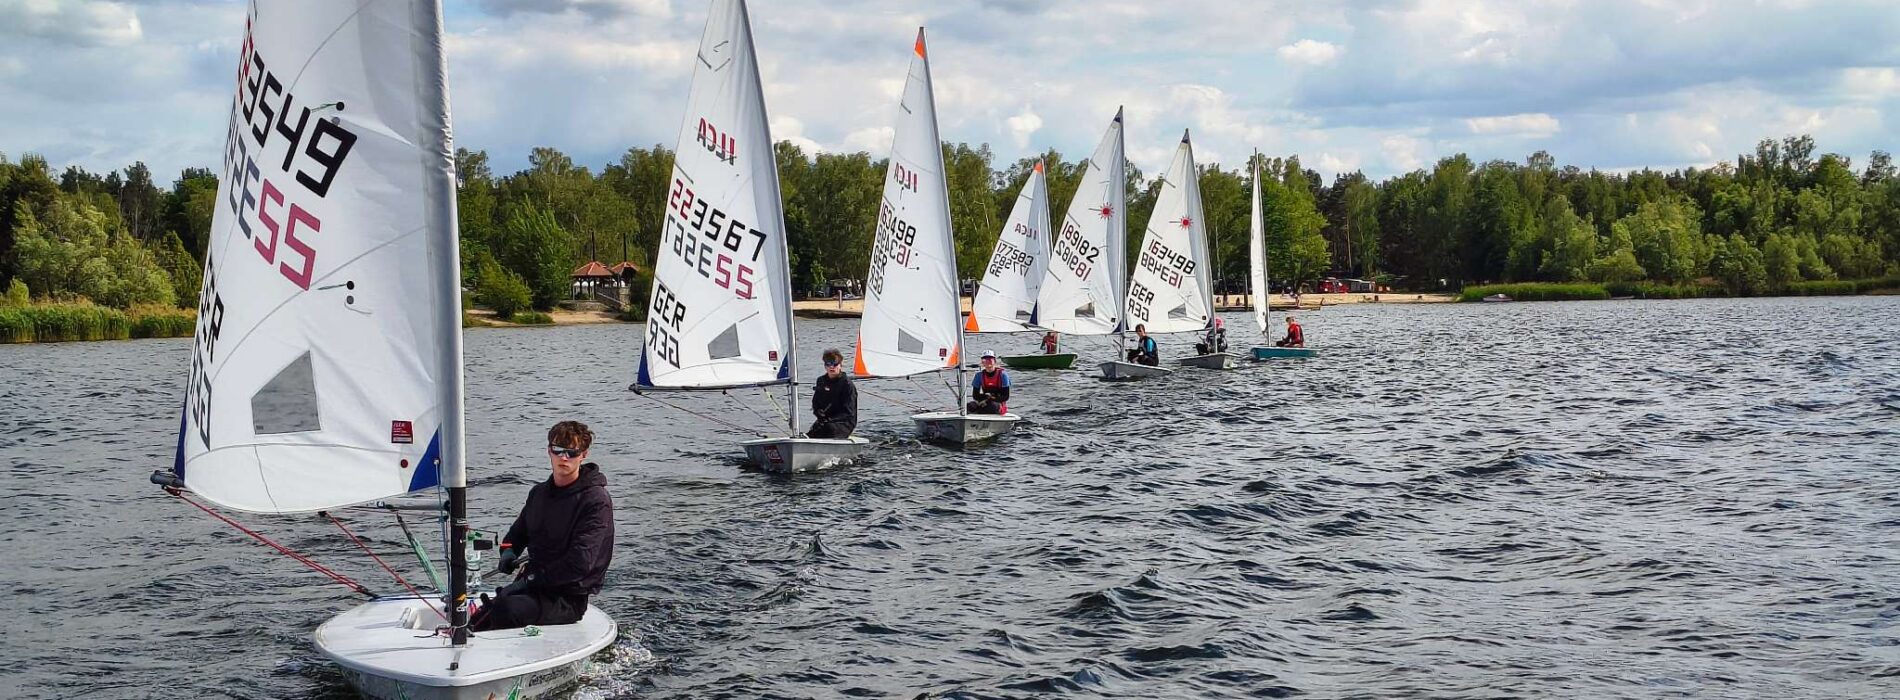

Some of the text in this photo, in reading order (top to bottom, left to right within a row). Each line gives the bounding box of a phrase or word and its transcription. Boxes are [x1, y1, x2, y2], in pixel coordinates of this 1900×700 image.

[670, 178, 767, 262] 223567
[881, 202, 917, 247] 163498
[997, 242, 1034, 266] 177583
[1062, 221, 1100, 264] 189182
[1148, 239, 1196, 275] 163498
[653, 284, 687, 333] GER
[1131, 281, 1155, 306] GER
